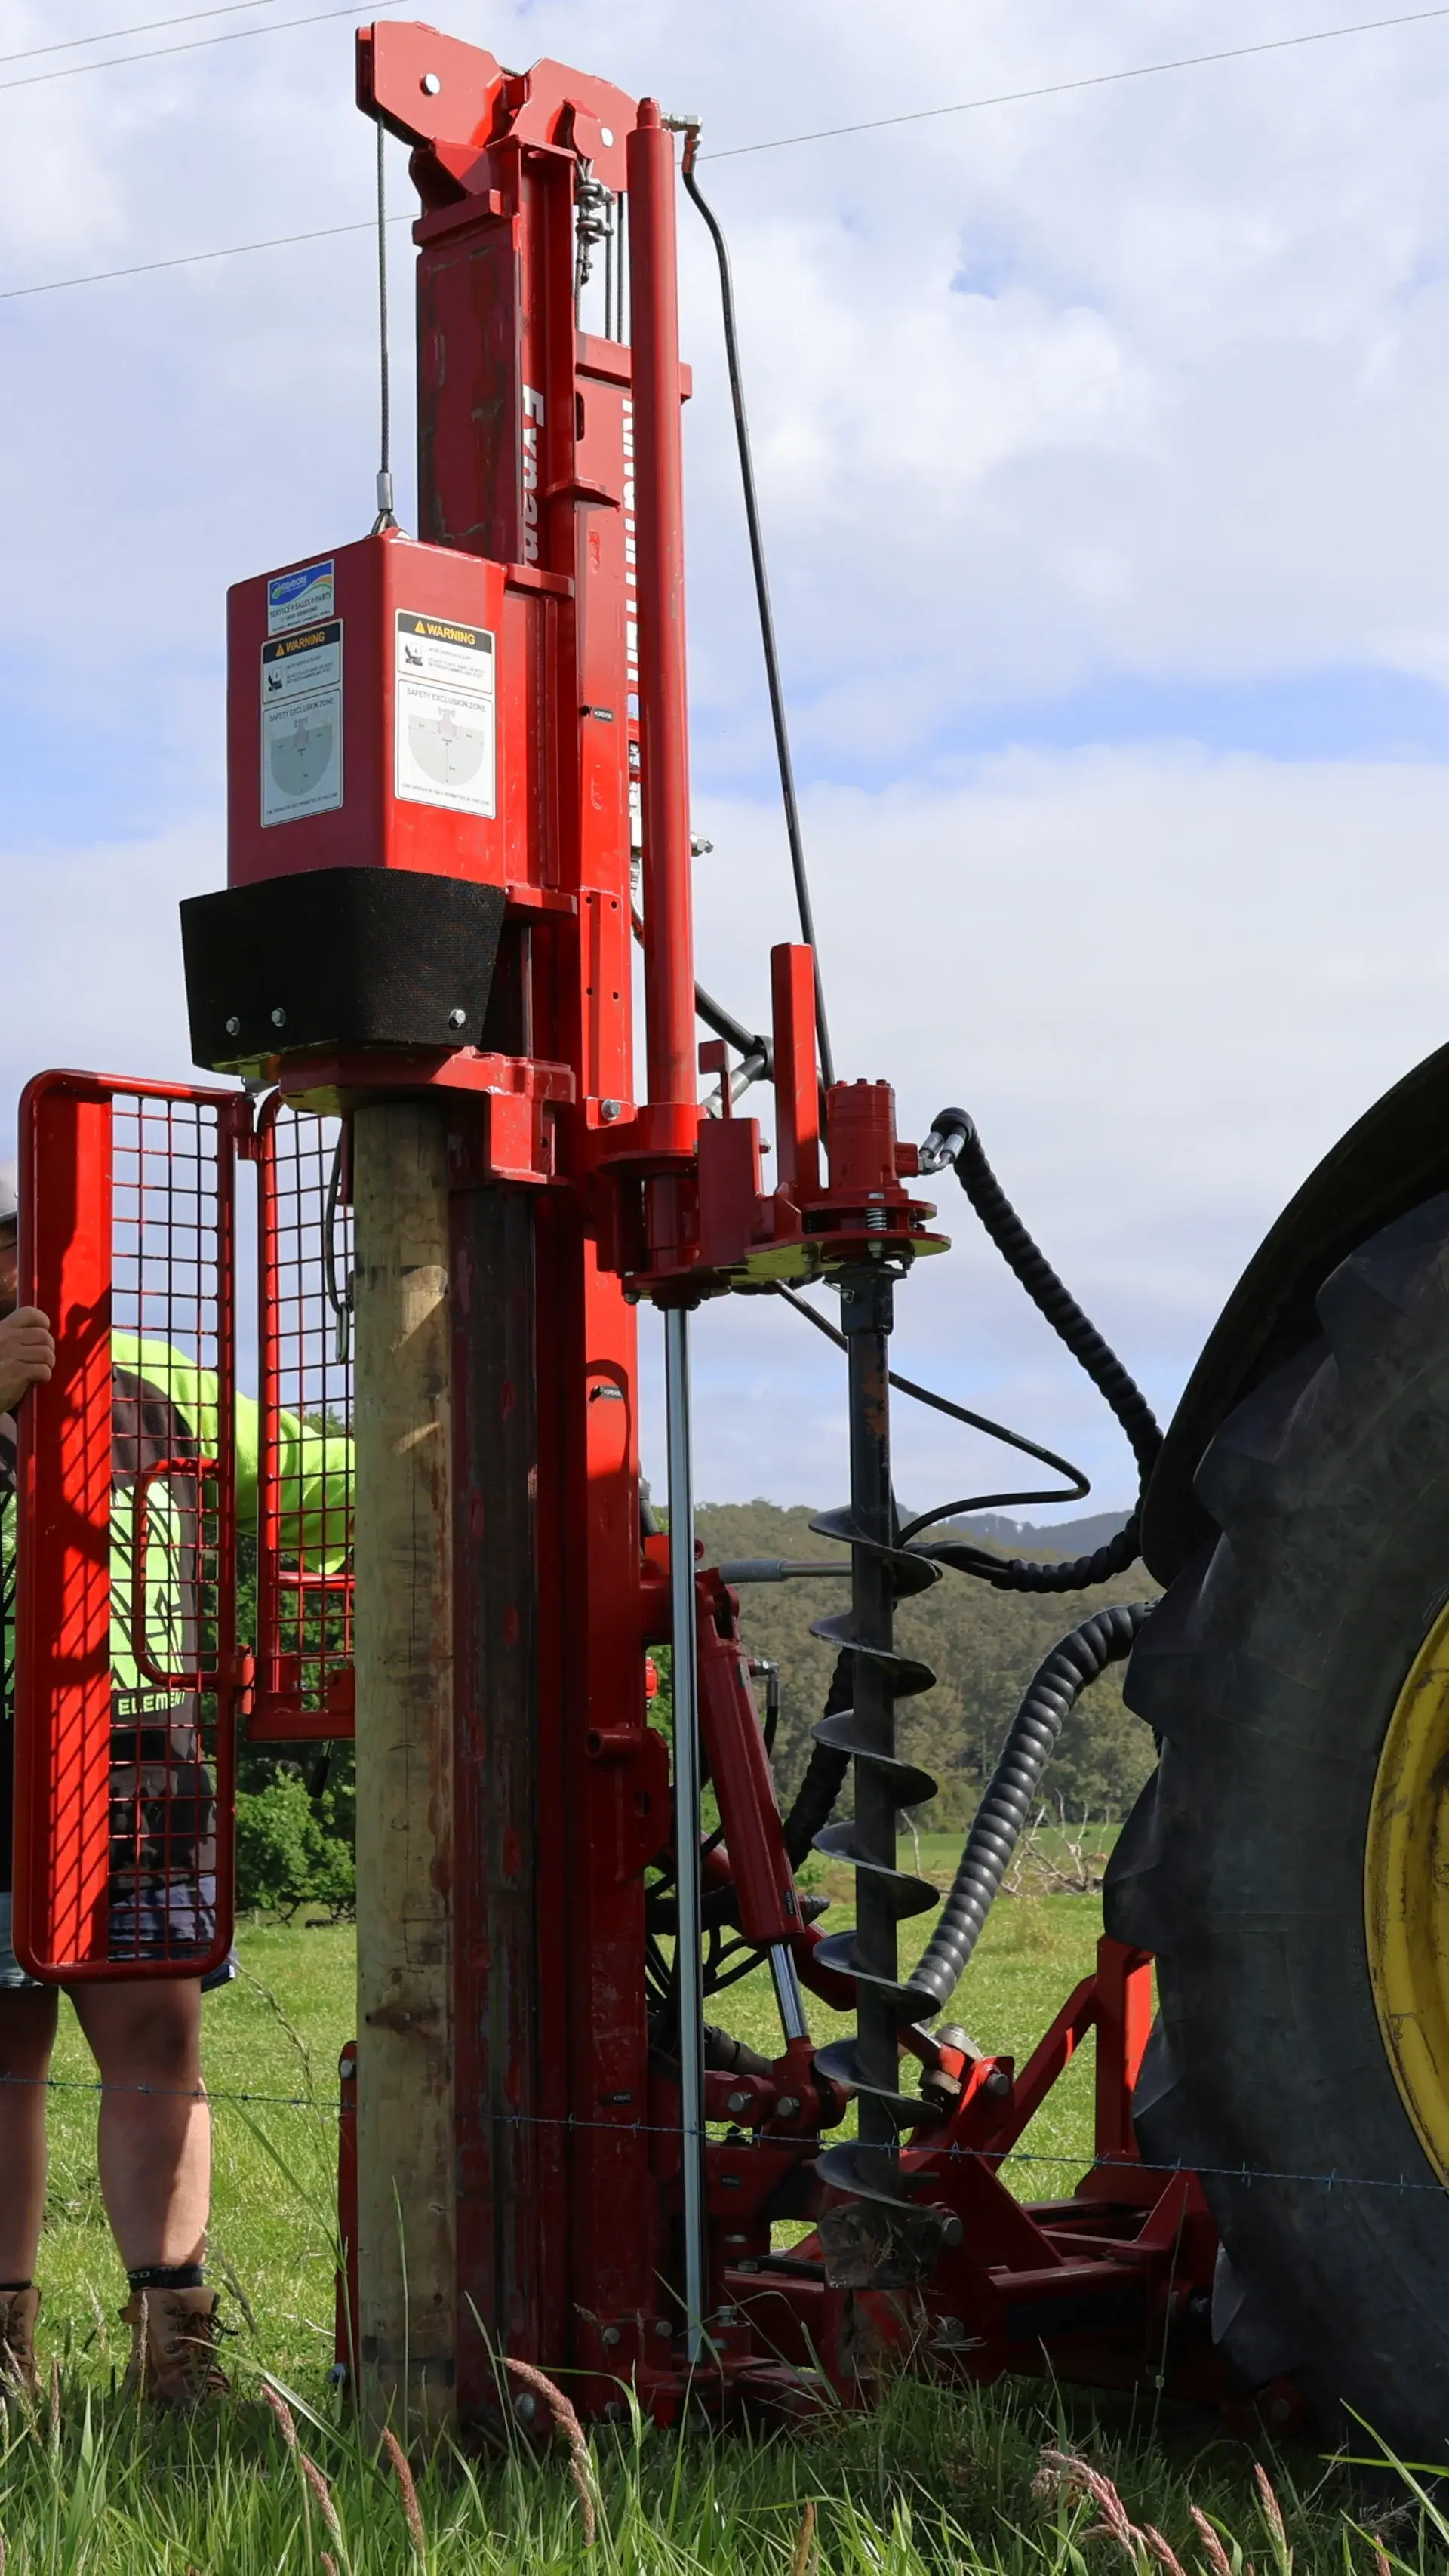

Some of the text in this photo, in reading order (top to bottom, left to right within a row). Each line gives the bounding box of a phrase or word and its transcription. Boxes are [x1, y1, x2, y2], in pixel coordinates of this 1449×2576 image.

[285, 631, 325, 652] WARNING
[426, 623, 476, 645] WARNING
[269, 697, 334, 722] SAFETY EXCLUSION ZONE
[407, 688, 487, 712] SAFETY EXCLUSION ZONE
